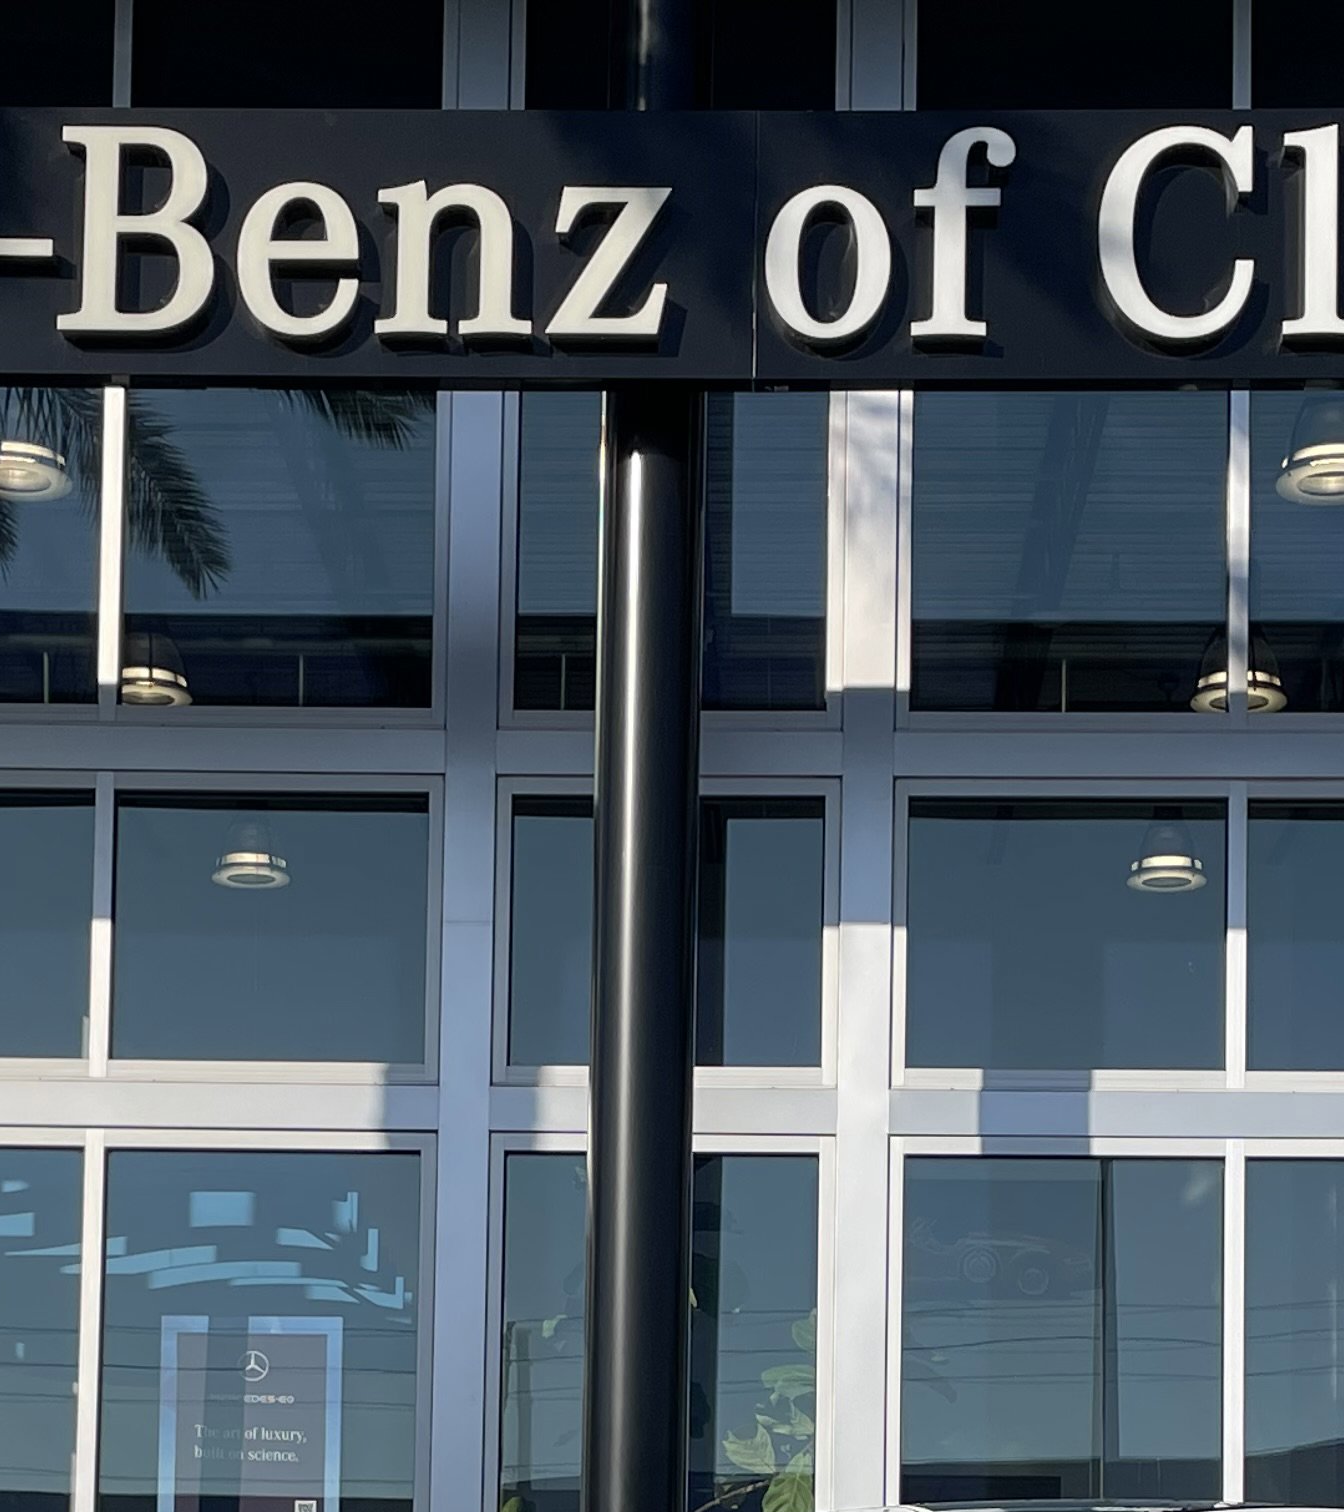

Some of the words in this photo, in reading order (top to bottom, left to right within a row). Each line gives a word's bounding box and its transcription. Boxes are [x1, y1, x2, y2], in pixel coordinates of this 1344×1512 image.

[762, 126, 1017, 342] of
[244, 1427, 258, 1440] of
[261, 1427, 307, 1444] luxury,
[247, 1449, 299, 1462] science.
